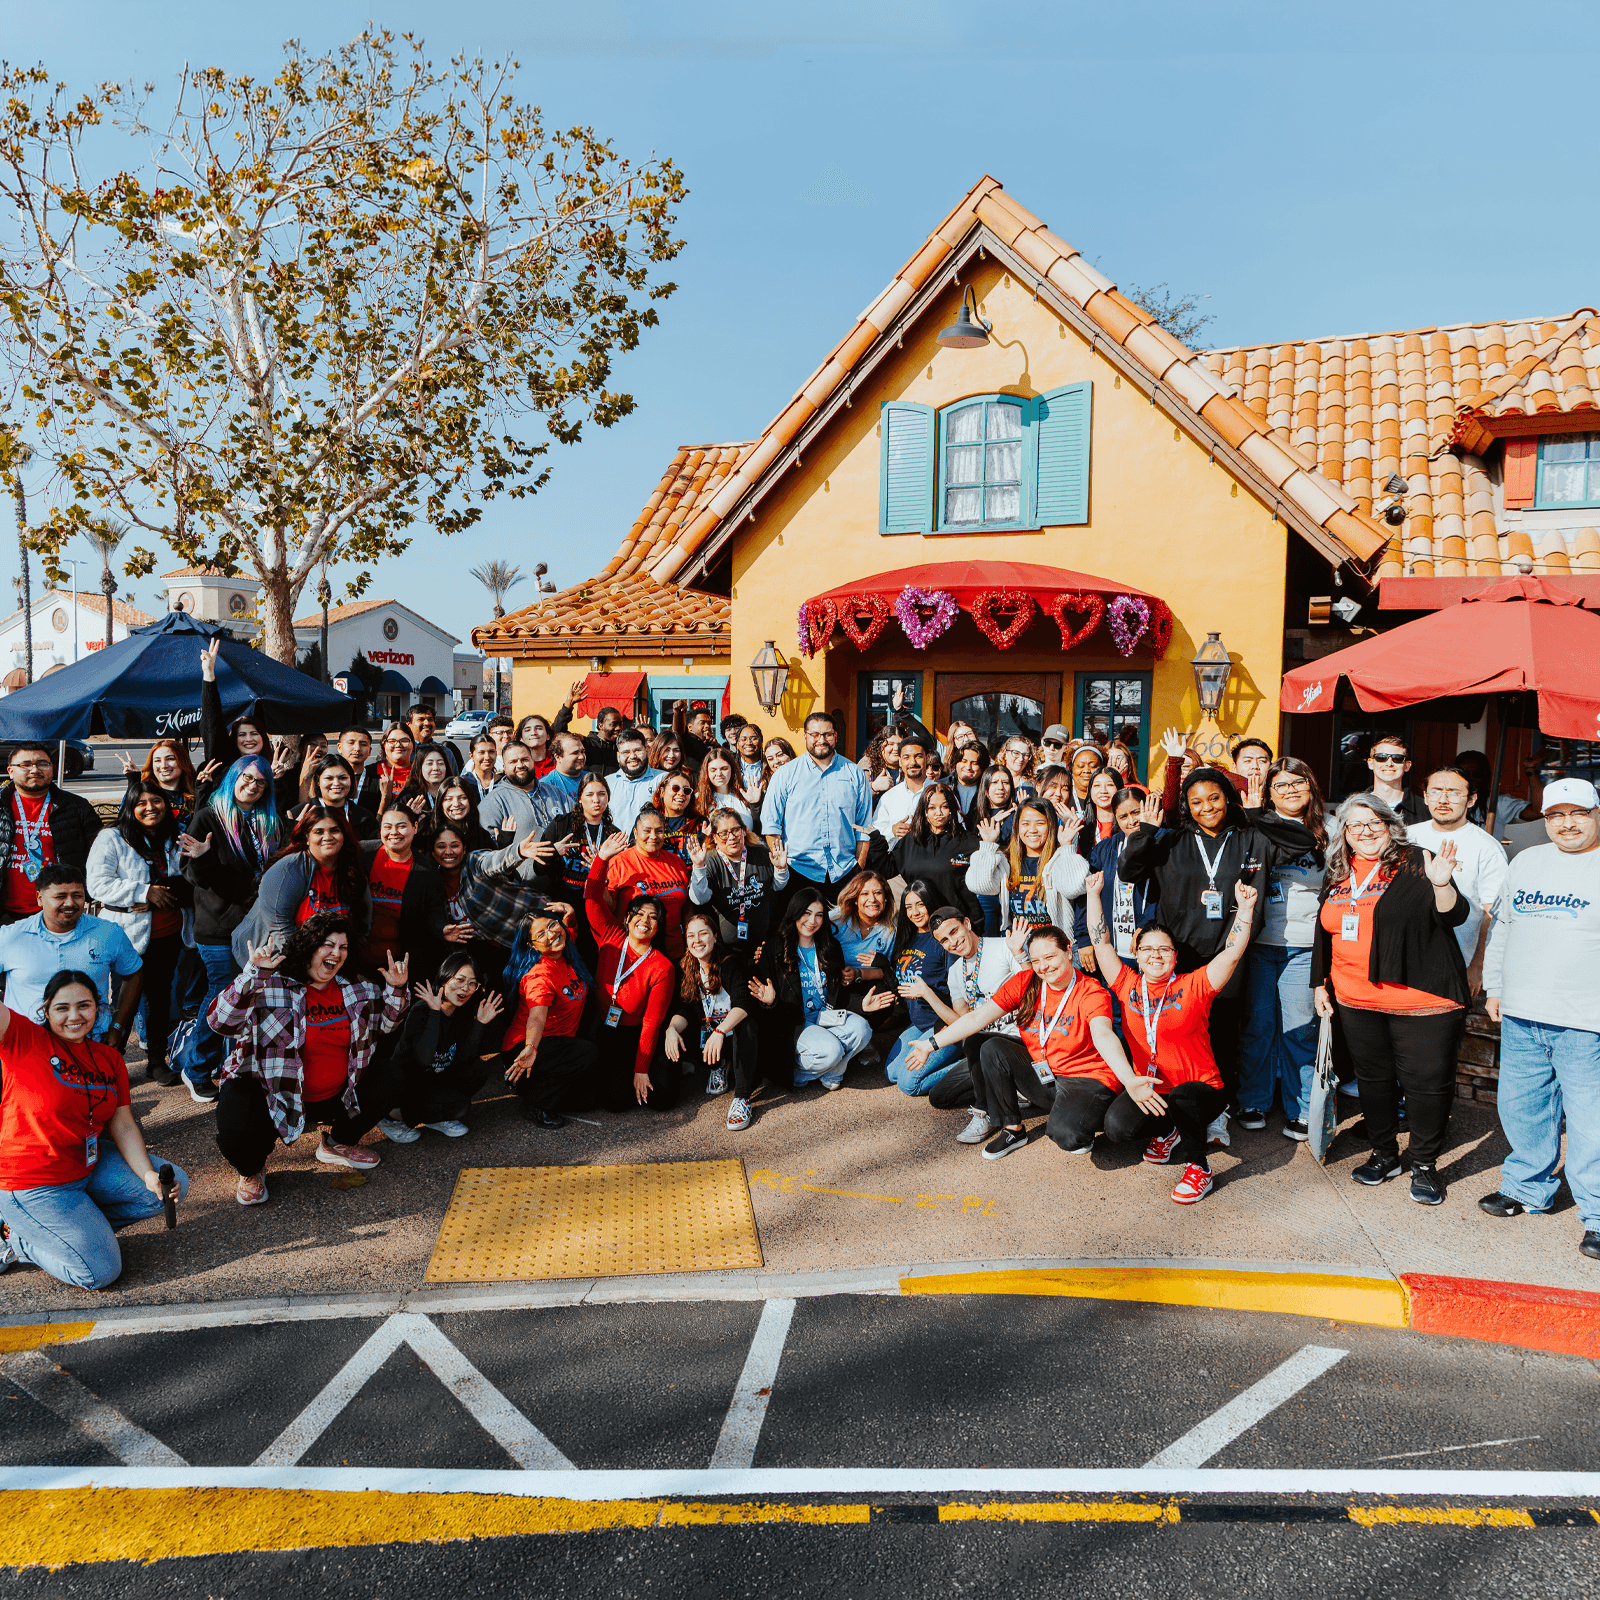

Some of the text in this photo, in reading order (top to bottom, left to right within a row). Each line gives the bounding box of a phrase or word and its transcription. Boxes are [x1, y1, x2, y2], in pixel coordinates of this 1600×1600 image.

[367, 648, 415, 666] verizon
[155, 707, 202, 736] Mimi
[369, 881, 402, 898] ehav
[1019, 883, 1037, 911] 7
[1010, 899, 1047, 914] EAR
[1513, 889, 1591, 910] Behavior
